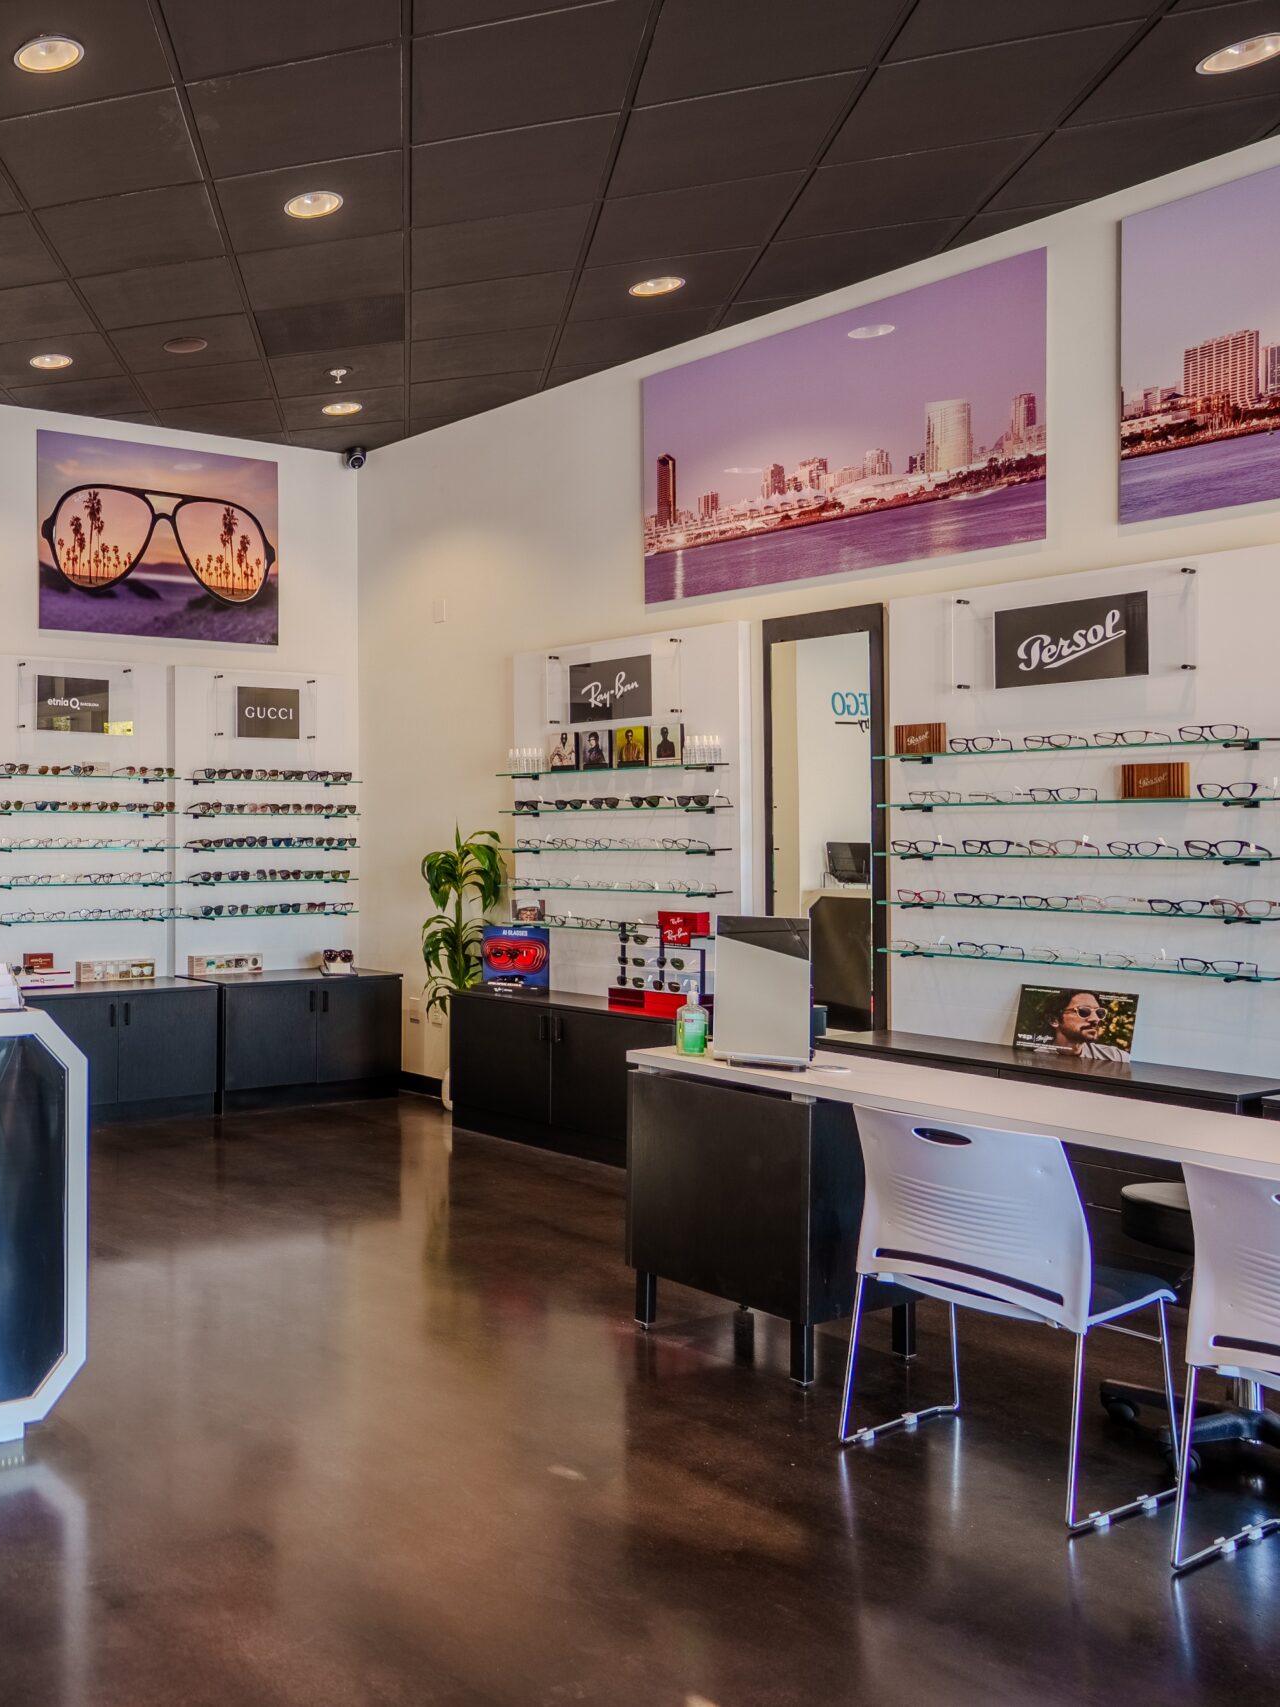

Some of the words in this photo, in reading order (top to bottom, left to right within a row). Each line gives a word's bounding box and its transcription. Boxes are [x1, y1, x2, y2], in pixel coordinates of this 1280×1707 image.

[1017, 609, 1126, 671] Persol
[47, 697, 69, 707] etnia
[581, 671, 639, 708] Ray-Ban
[245, 706, 293, 720] GUCCI
